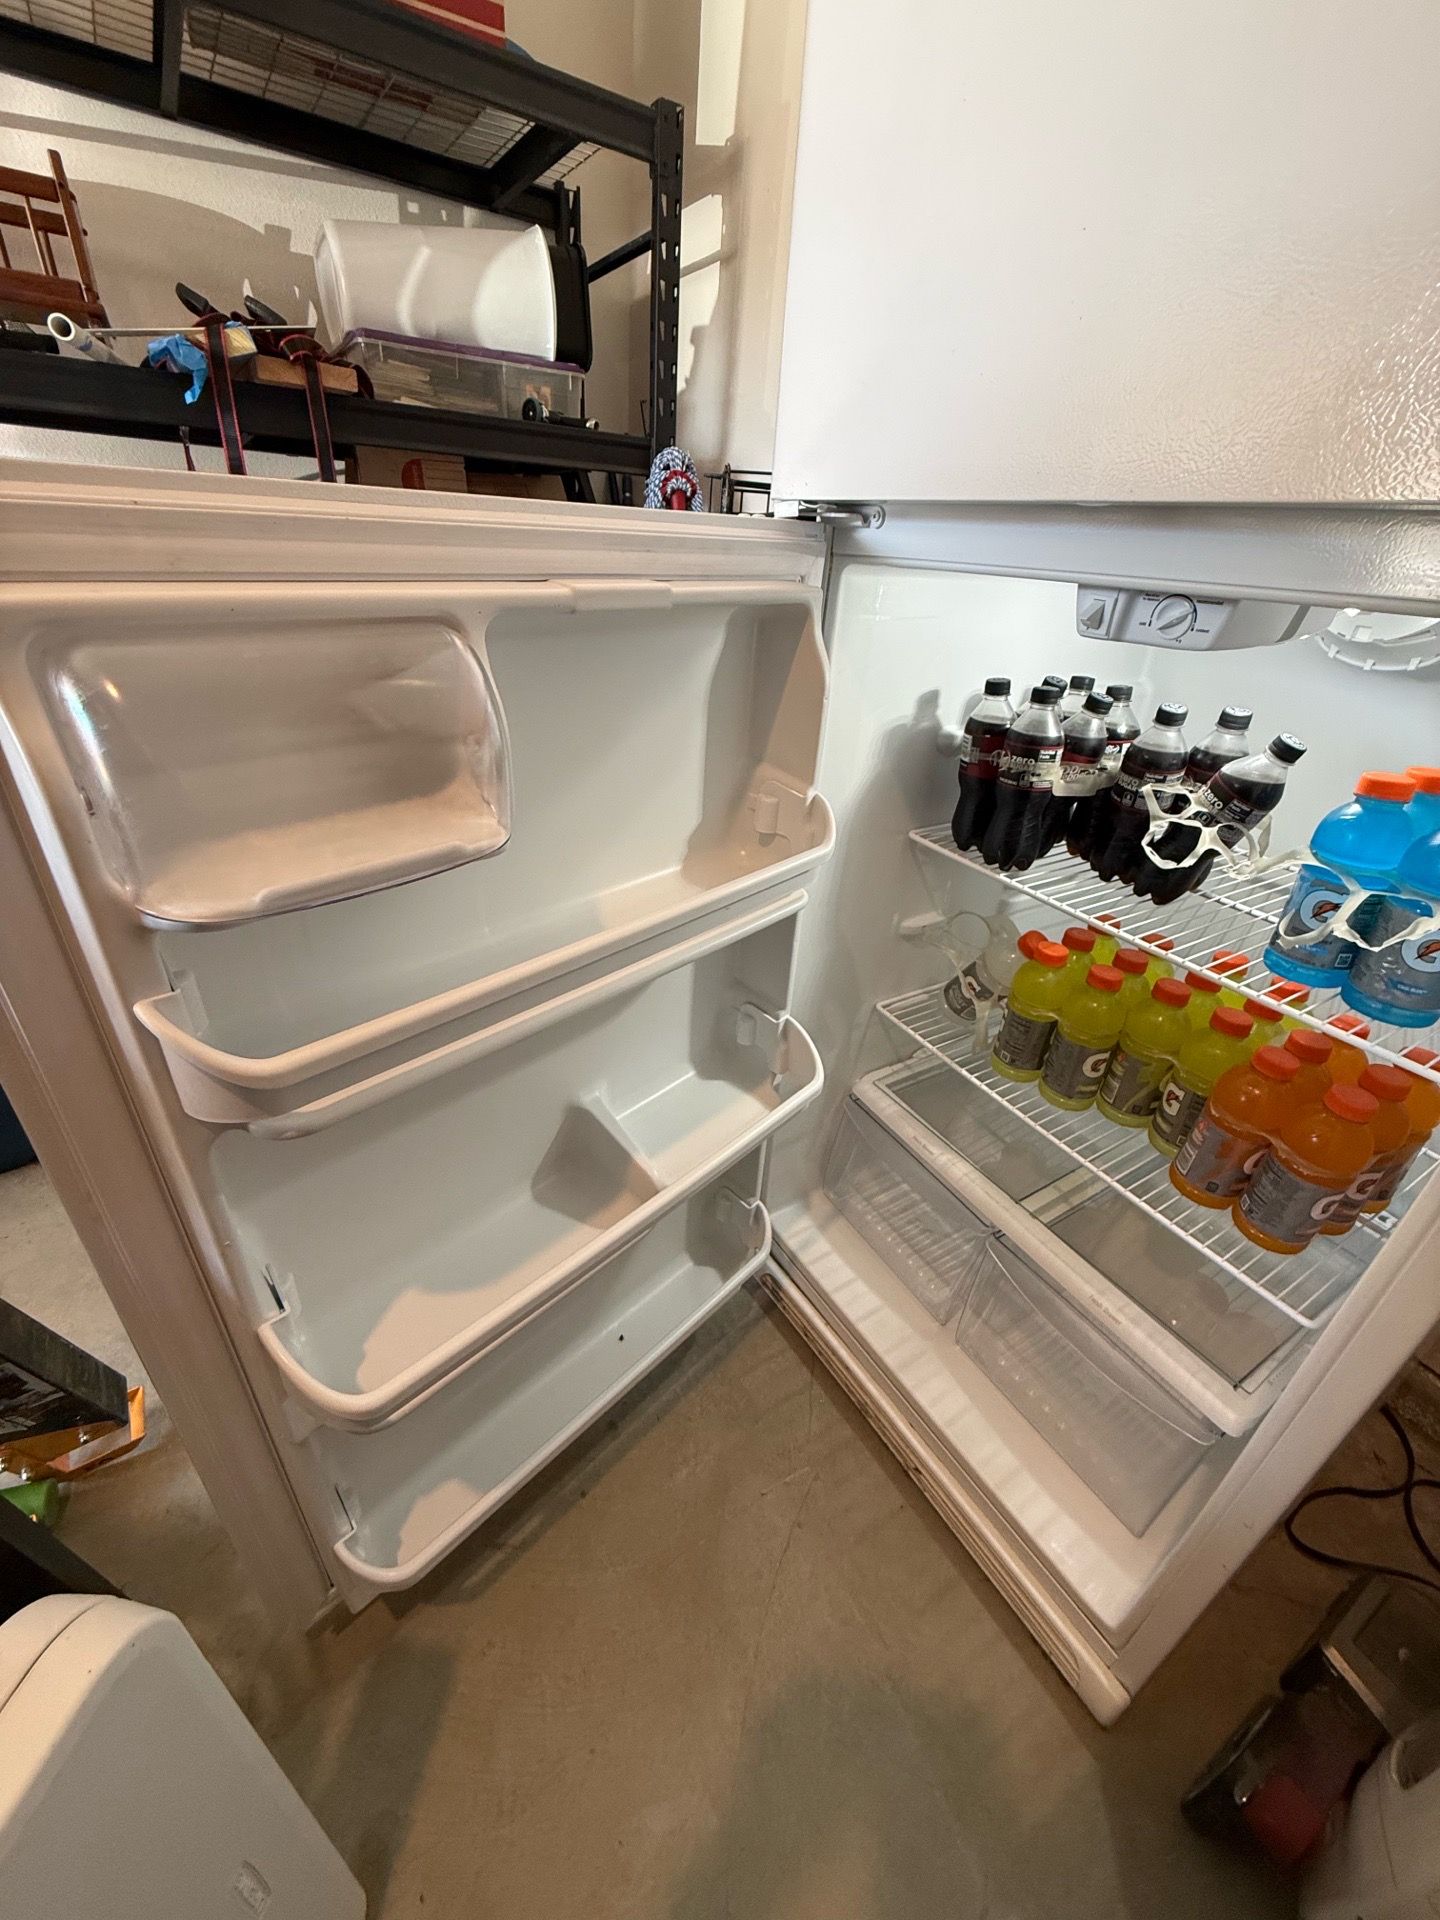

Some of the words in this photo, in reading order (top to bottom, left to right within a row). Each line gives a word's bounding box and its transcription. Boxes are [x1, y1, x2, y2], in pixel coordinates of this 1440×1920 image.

[1011, 754, 1036, 766] zero
[1204, 788, 1224, 810] zero
[1163, 1082, 1186, 1117] G
